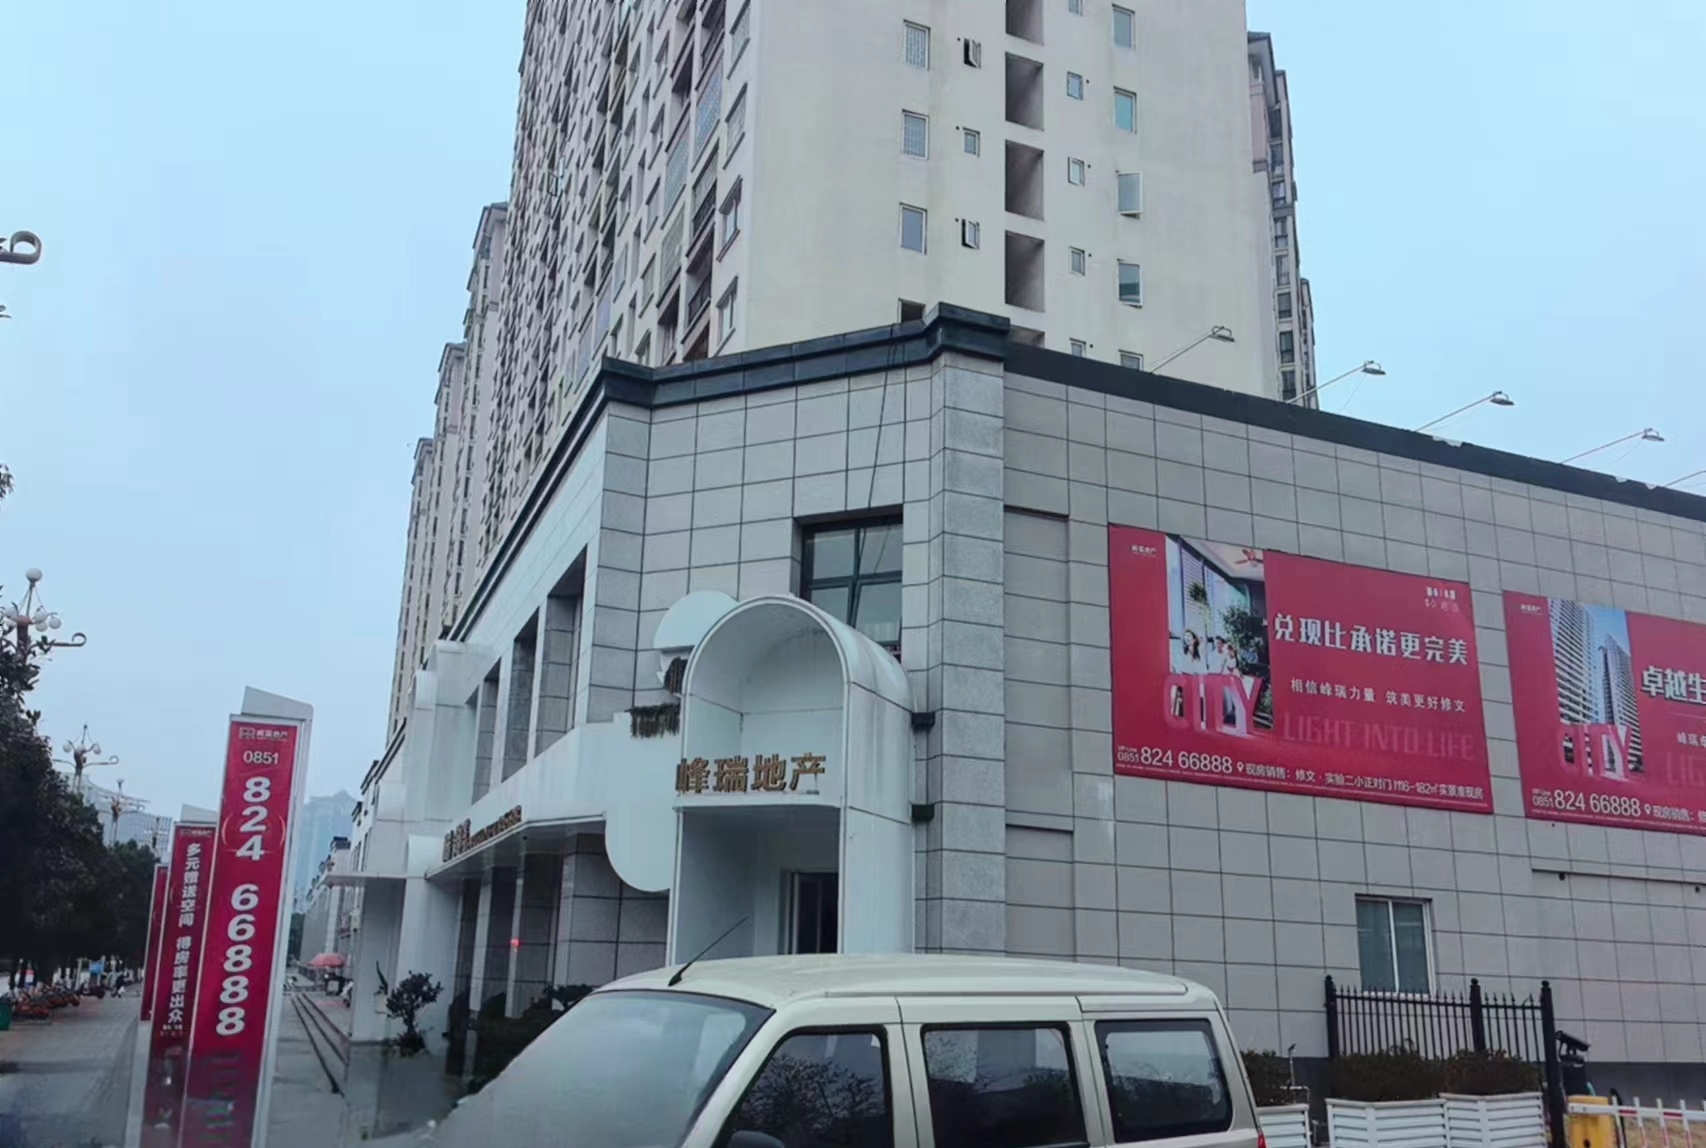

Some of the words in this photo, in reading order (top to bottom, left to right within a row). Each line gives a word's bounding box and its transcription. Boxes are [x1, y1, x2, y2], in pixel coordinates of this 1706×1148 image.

[1274, 613, 1468, 665] 兑现比承诺更完美
[1163, 674, 1263, 737] CITY
[1291, 678, 1376, 703] 相信峰瑞力量
[1385, 690, 1466, 713] 筑美更好修文
[243, 750, 279, 765] 0851
[1283, 709, 1355, 748] LIGHT
[1363, 721, 1420, 754] INTO
[1427, 731, 1475, 761] LIFE
[675, 752, 827, 794] 峰瑞地产
[1117, 751, 1139, 763] 0851
[1140, 746, 1173, 767] 824
[1178, 751, 1233, 774] 66888
[235, 776, 271, 862] 824
[1554, 789, 1586, 812] 824
[1589, 793, 1641, 818] 66888
[215, 883, 259, 1037] 66888
